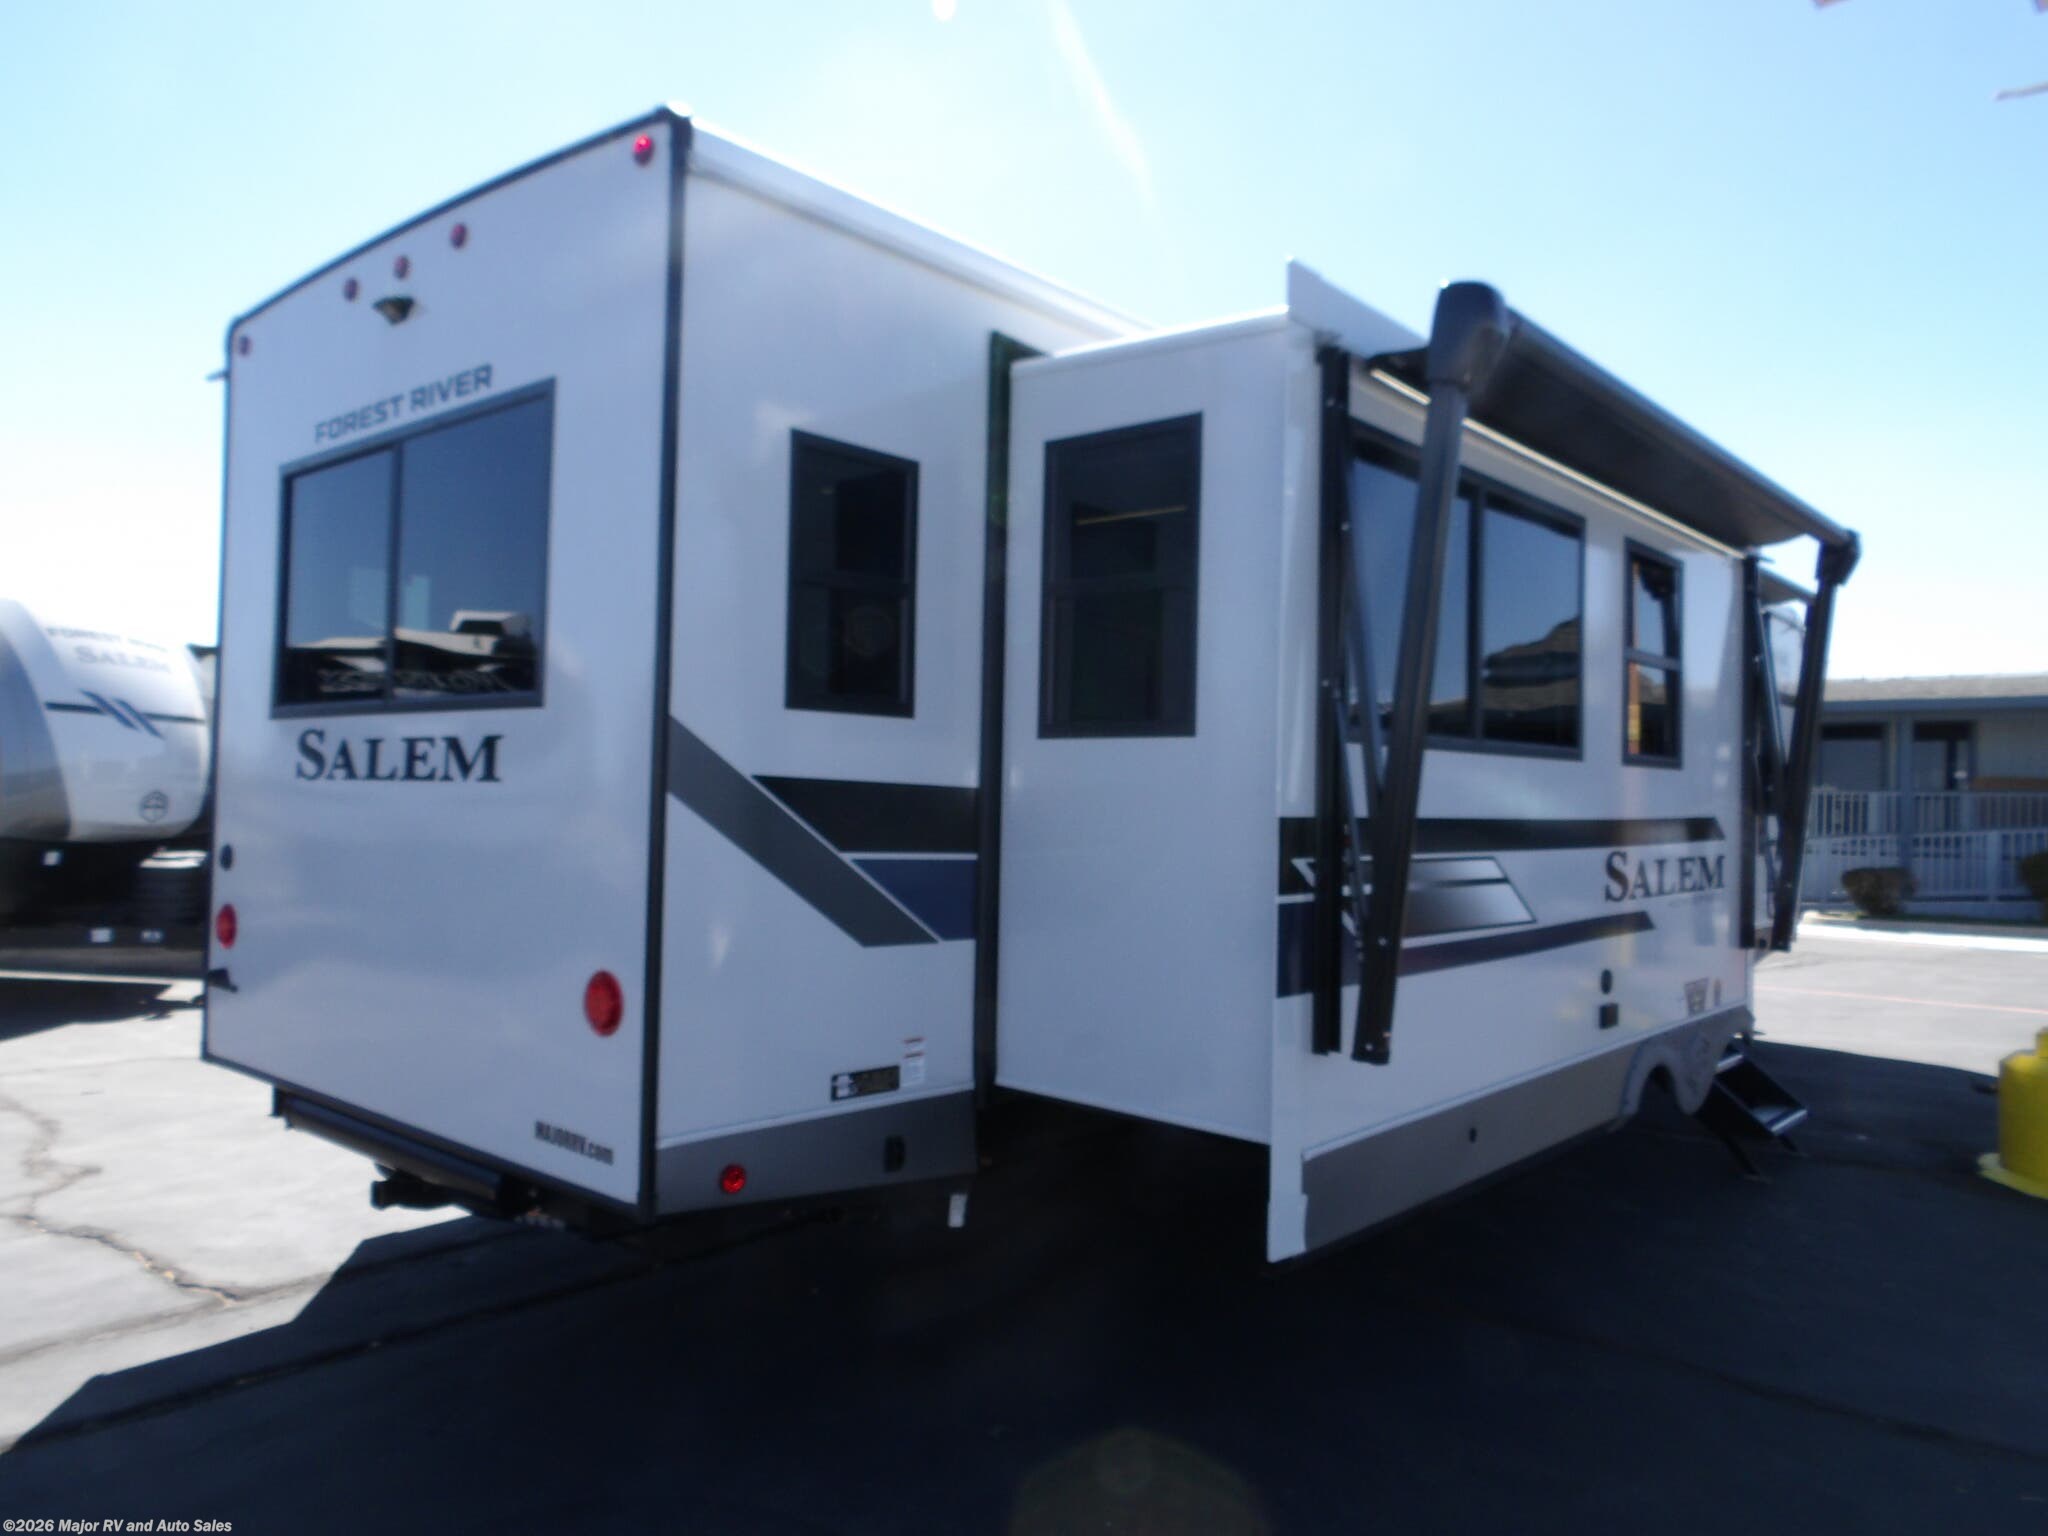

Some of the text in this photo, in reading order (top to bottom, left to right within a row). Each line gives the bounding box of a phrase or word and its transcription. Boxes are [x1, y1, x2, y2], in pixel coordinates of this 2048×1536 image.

[315, 362, 493, 443] FOREST RIVER
[296, 728, 504, 783] SALEM
[1604, 850, 1725, 903] SALEM
